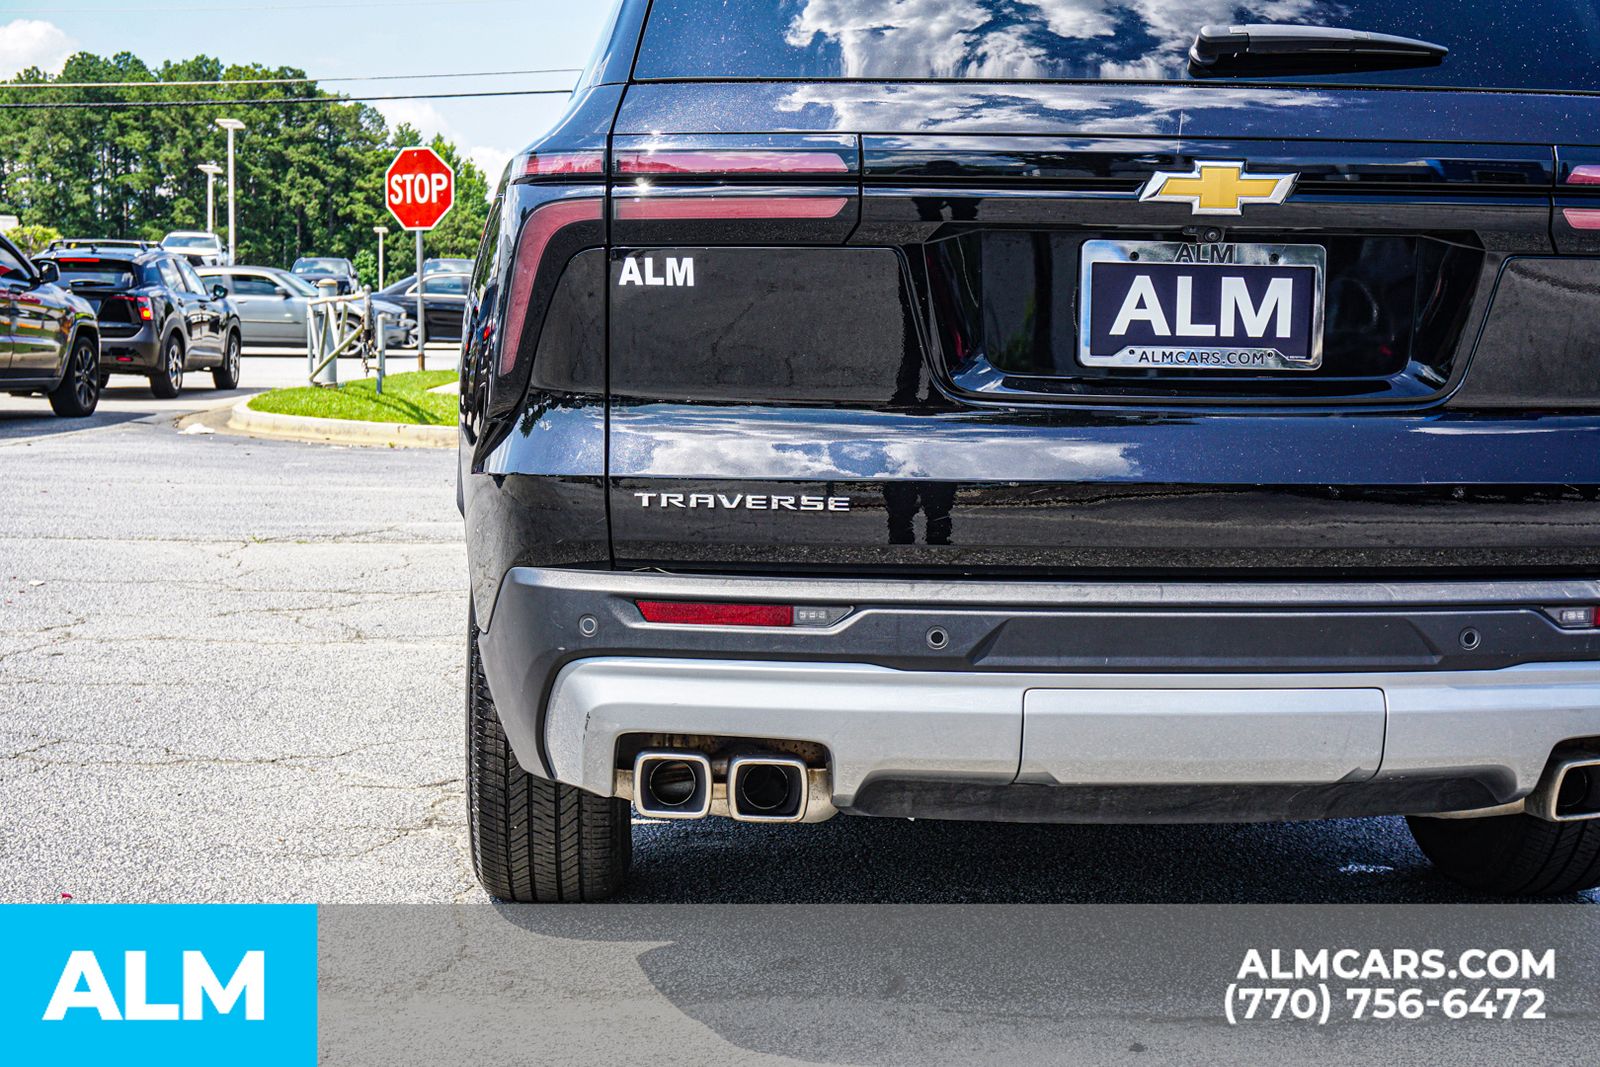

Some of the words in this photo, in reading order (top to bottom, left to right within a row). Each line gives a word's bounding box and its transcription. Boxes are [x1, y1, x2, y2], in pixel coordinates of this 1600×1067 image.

[390, 173, 448, 205] STOP
[1175, 242, 1236, 264] ALM
[618, 257, 695, 287] ALM
[1109, 275, 1293, 338] ALM
[1138, 350, 1265, 365] ALMCARS.COM
[634, 492, 851, 512] TRAVERSE
